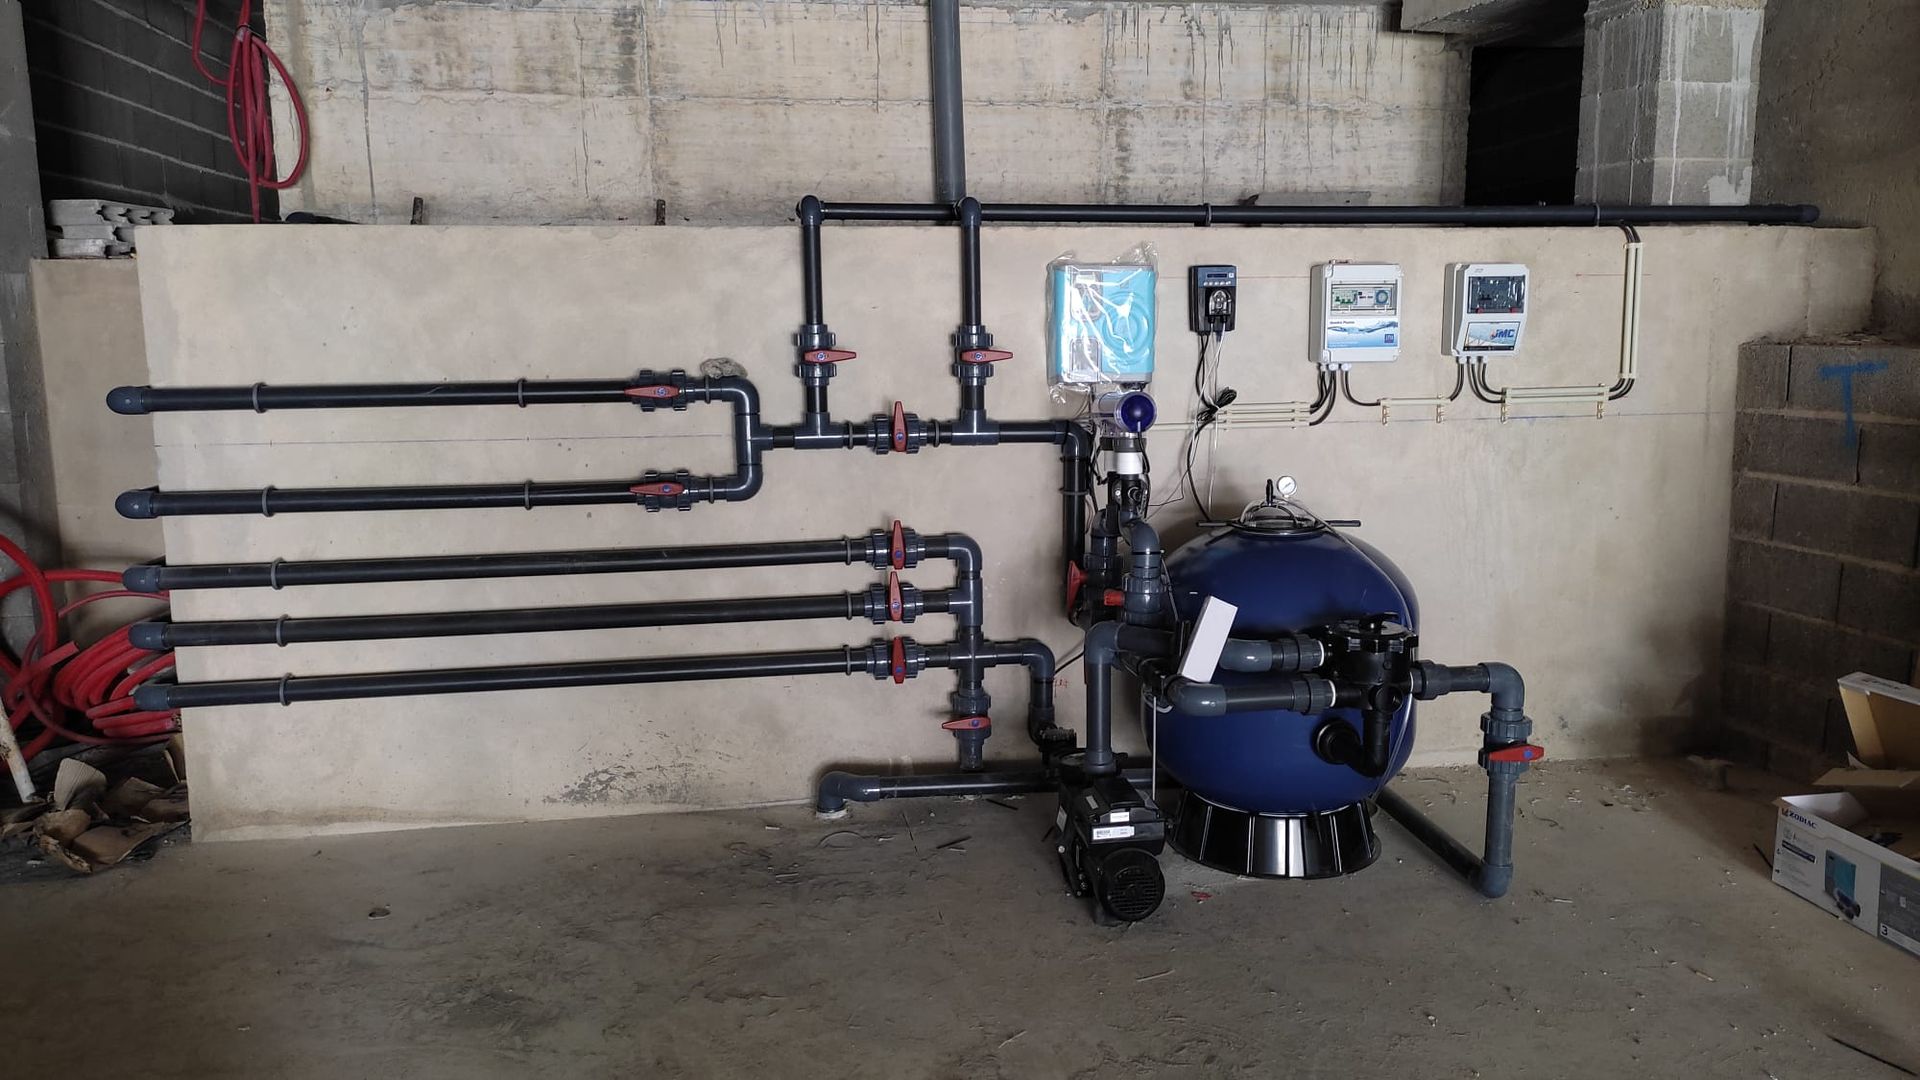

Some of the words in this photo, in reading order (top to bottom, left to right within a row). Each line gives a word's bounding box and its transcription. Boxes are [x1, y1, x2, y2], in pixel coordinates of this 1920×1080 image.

[1818, 360, 1888, 449] T
[1789, 811, 1818, 829] ZODIAC
[1881, 925, 1888, 936] 3
